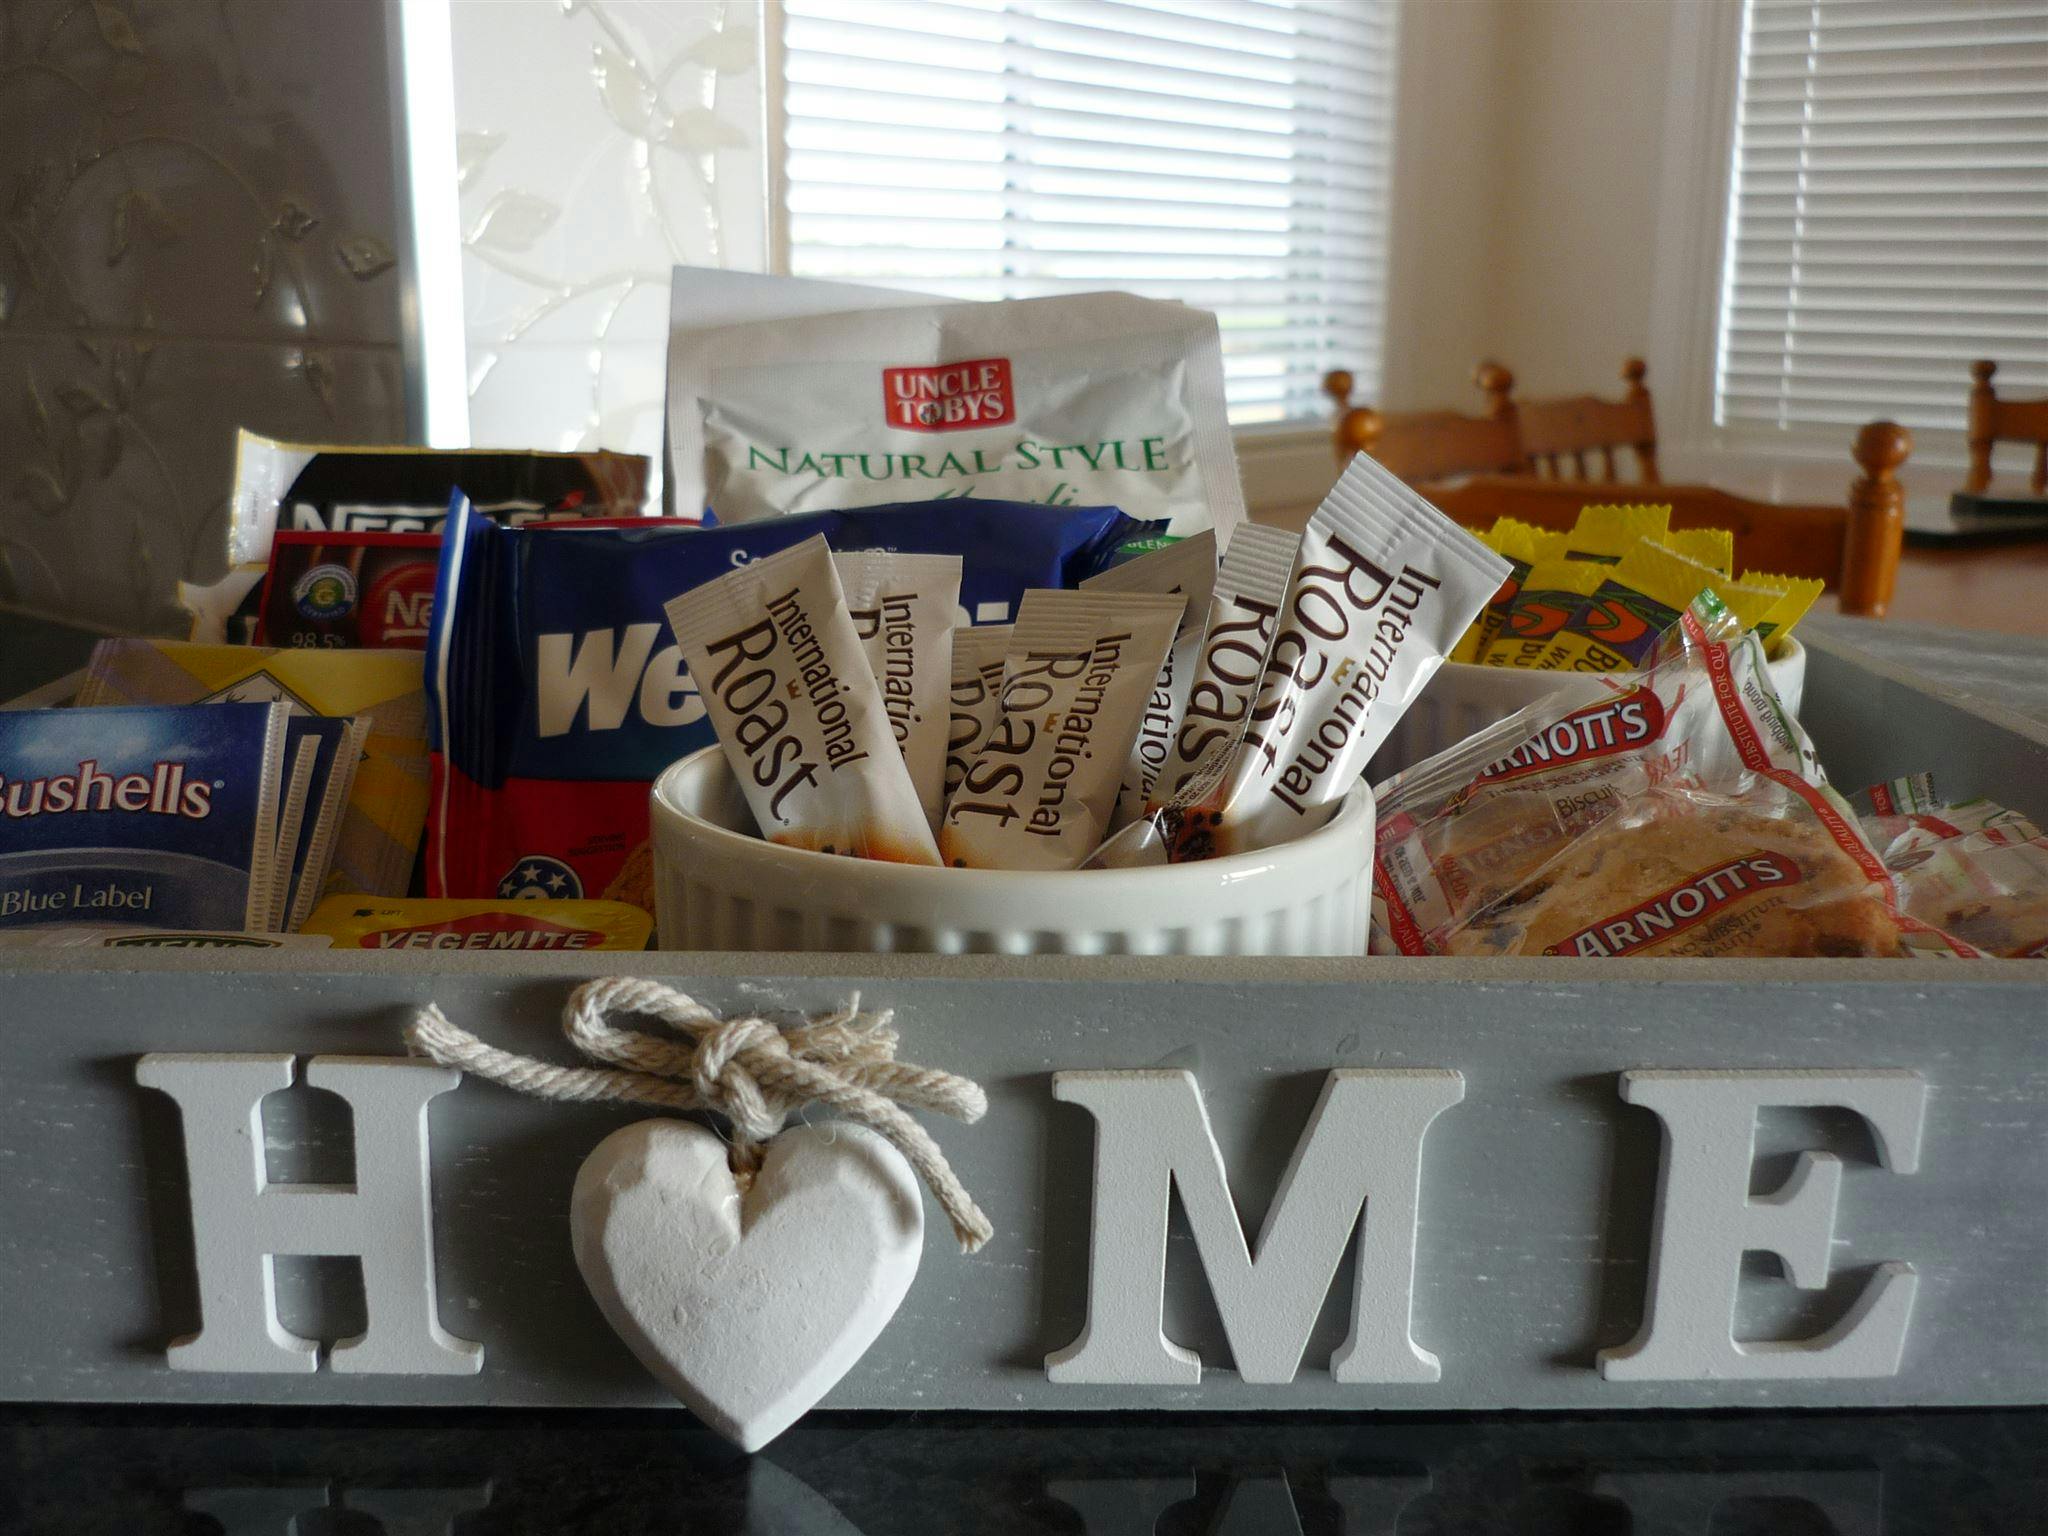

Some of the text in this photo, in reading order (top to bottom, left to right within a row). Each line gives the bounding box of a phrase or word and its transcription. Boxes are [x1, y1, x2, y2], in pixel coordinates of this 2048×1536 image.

[896, 364, 1001, 400] UNCLE
[897, 391, 1006, 428] TOBYS
[747, 436, 1170, 481] NATURAL STYLE
[766, 587, 869, 773] International
[1243, 531, 1395, 777] Roast
[1270, 563, 1442, 816] International
[1714, 673, 1734, 701] FOR
[705, 616, 819, 821] Roast
[950, 650, 1093, 827] Roast
[1024, 632, 1133, 837] International
[2, 884, 153, 917] Blue Label
[379, 930, 590, 950] VEGEMITE
[1574, 859, 1784, 957] ARNOTT'S
